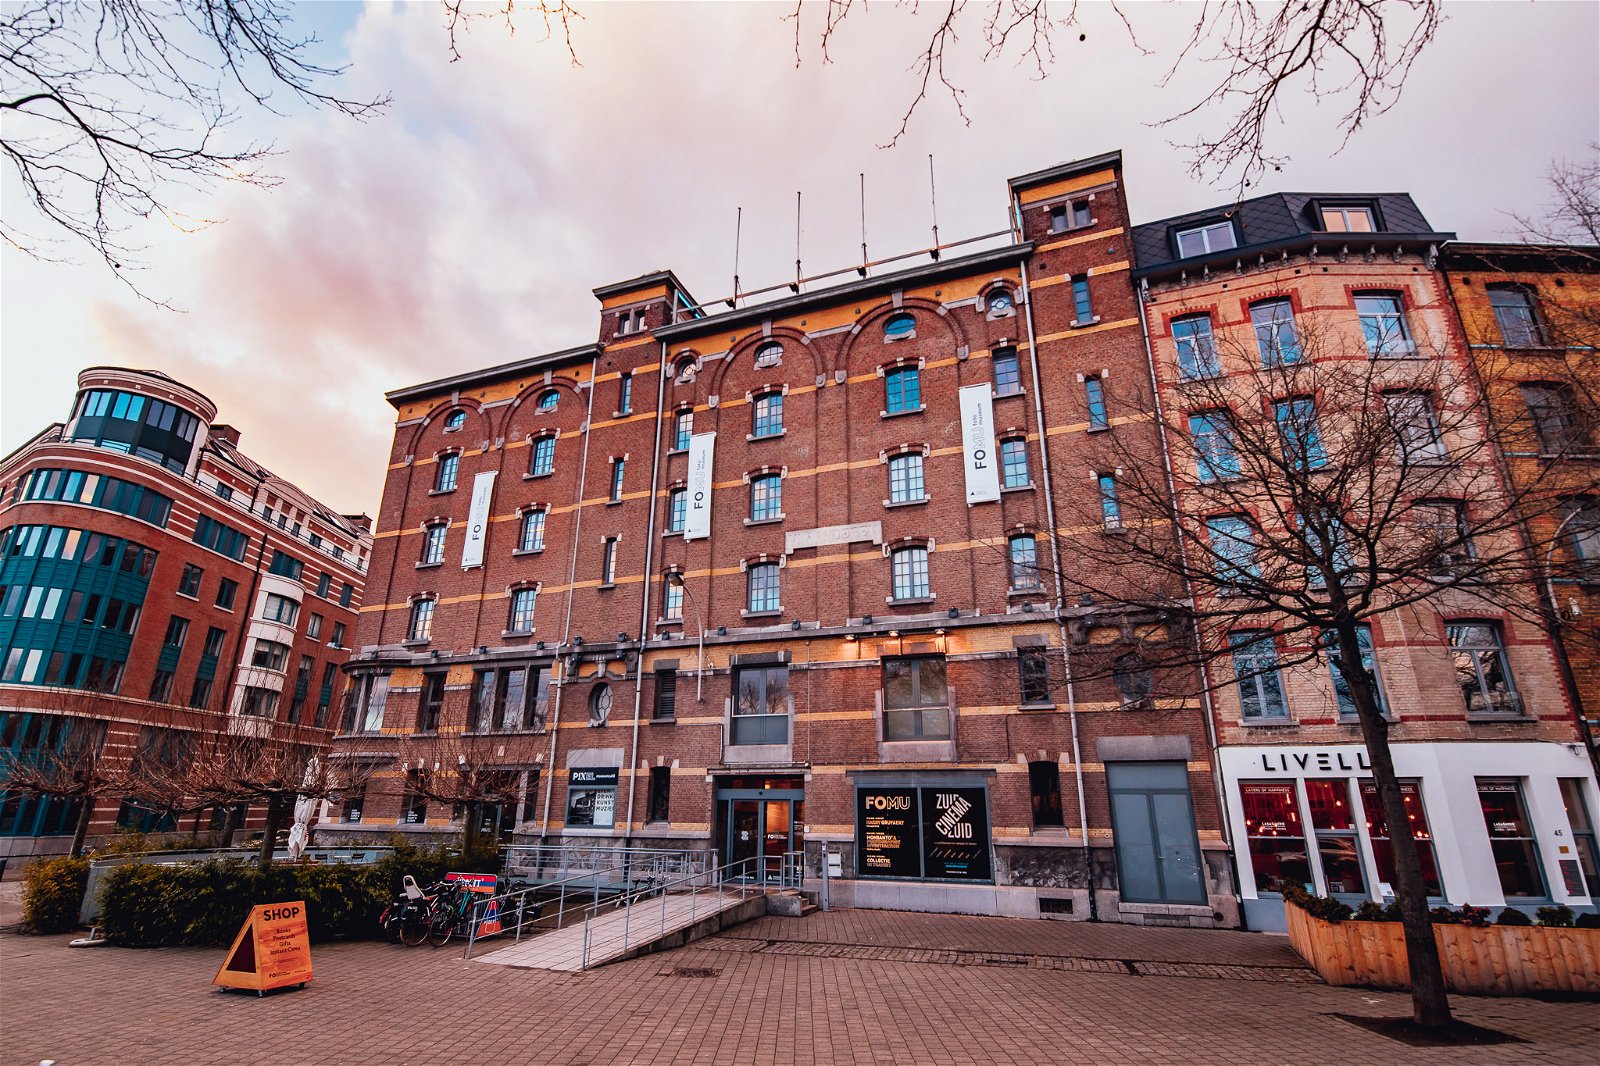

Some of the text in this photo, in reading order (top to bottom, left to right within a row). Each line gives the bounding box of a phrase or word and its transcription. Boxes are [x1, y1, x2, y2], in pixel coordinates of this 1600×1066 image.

[971, 426, 987, 470] FOMU
[694, 471, 705, 509] FOMU
[573, 772, 595, 780] PIXEL
[865, 796, 911, 810] FOMU
[935, 796, 972, 836] CINEMA
[263, 907, 300, 921] SHOP
